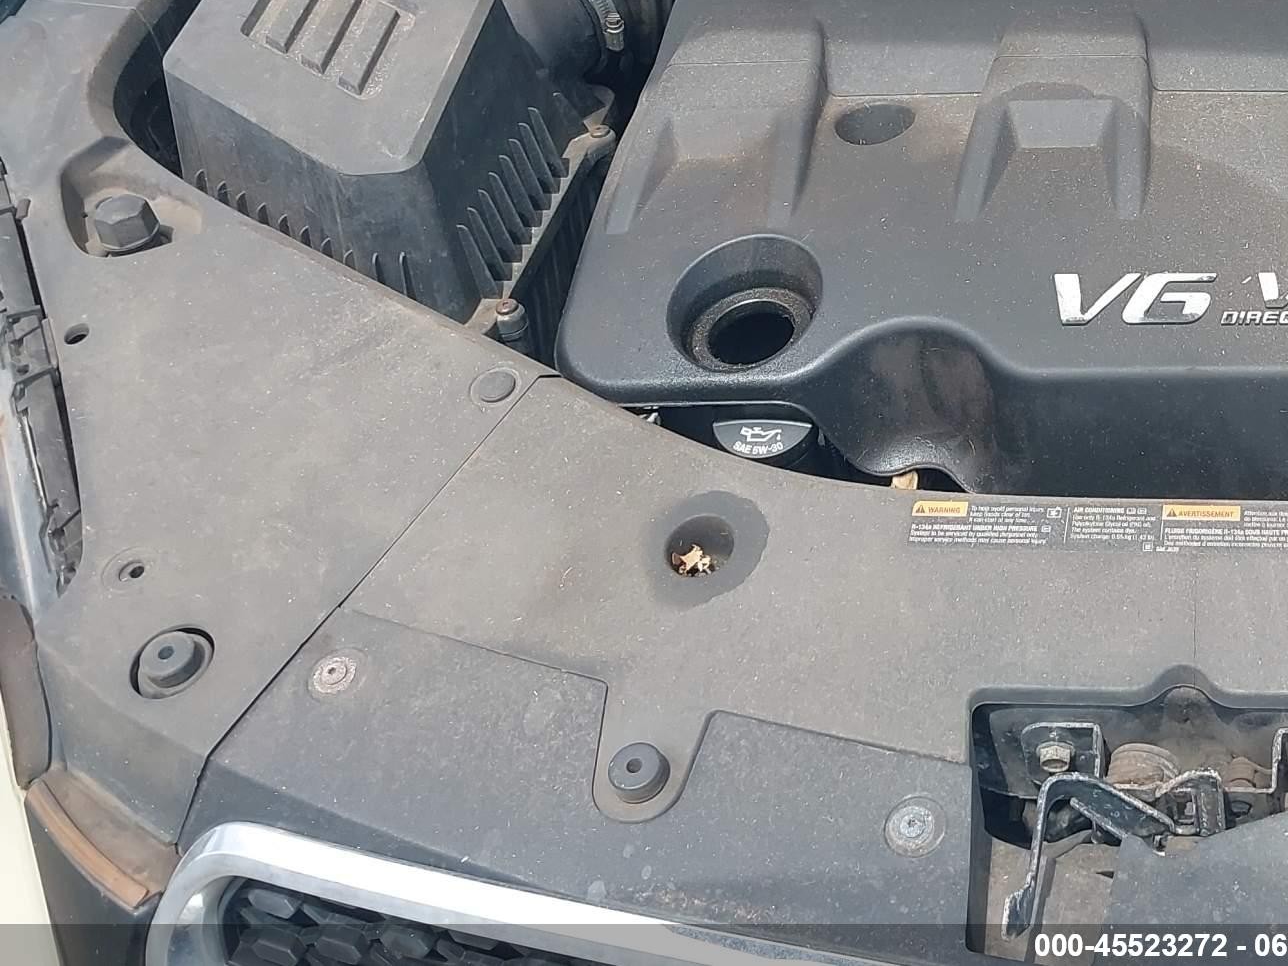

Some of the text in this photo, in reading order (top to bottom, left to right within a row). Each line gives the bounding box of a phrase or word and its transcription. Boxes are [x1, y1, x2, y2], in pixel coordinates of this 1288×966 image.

[1054, 272, 1217, 325] V6
[733, 441, 784, 455] SAE 5W-30
